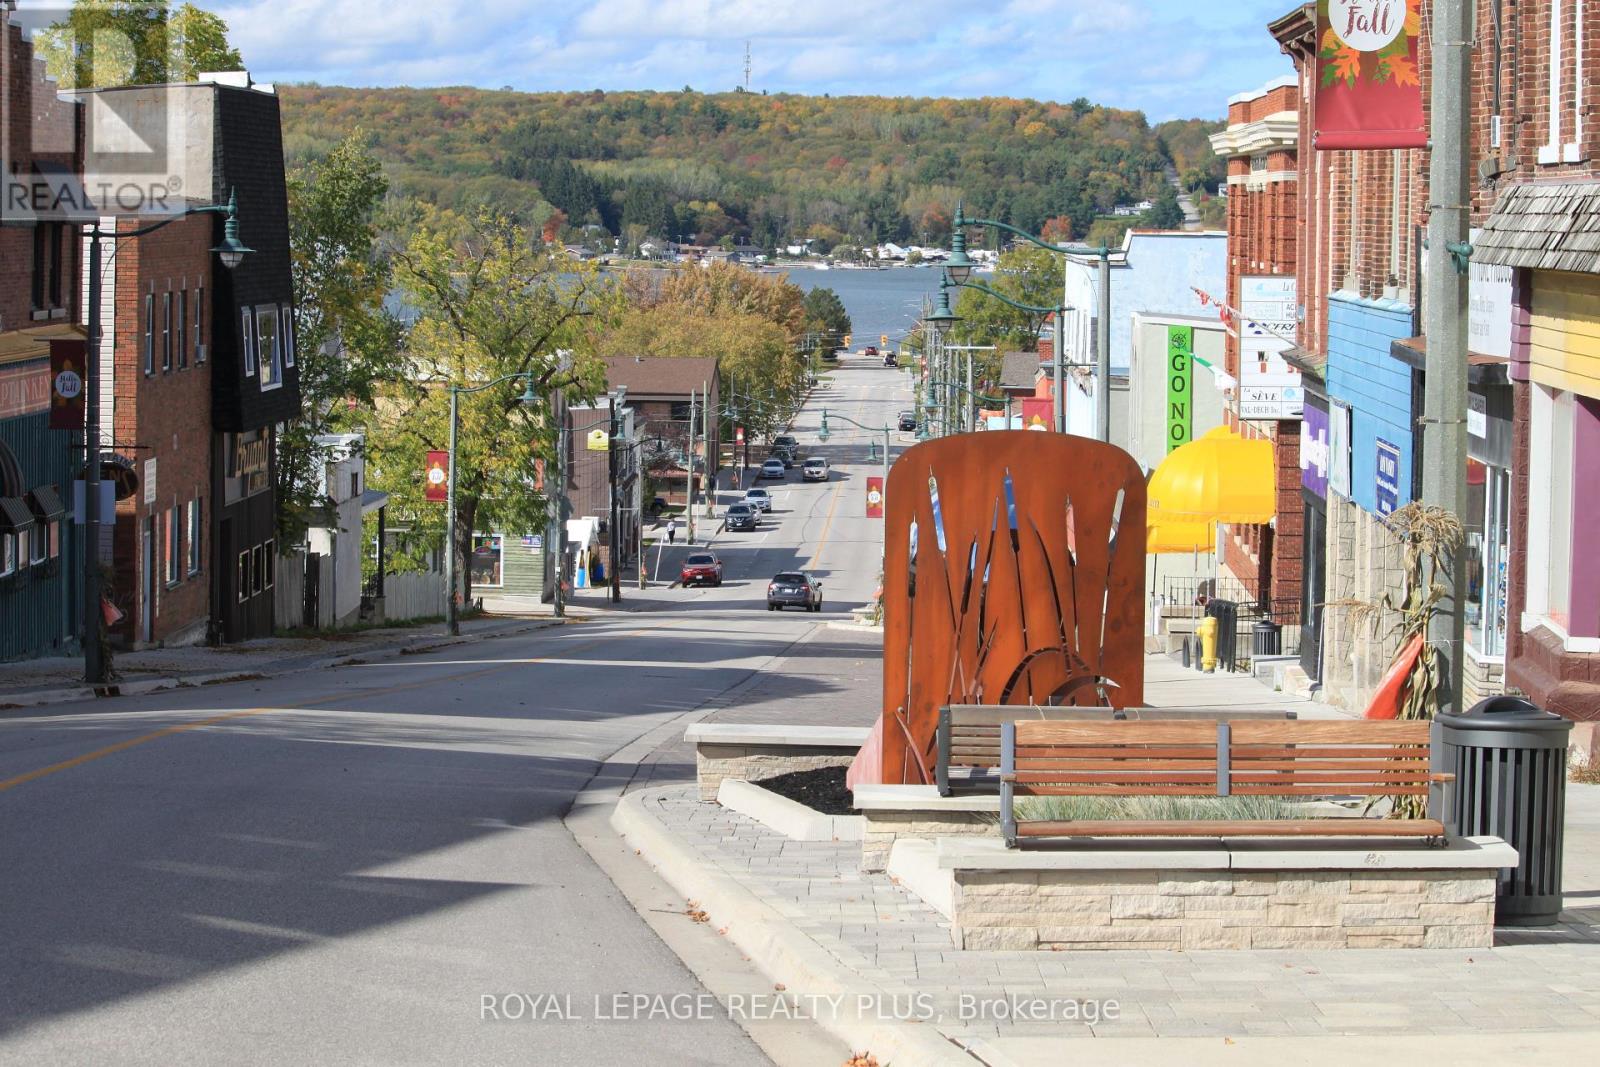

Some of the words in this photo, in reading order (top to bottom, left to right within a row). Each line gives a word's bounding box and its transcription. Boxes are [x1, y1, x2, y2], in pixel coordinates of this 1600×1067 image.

[1342, 2, 1395, 39] Fall
[1171, 354, 1186, 393] GO
[1171, 402, 1185, 451] NO
